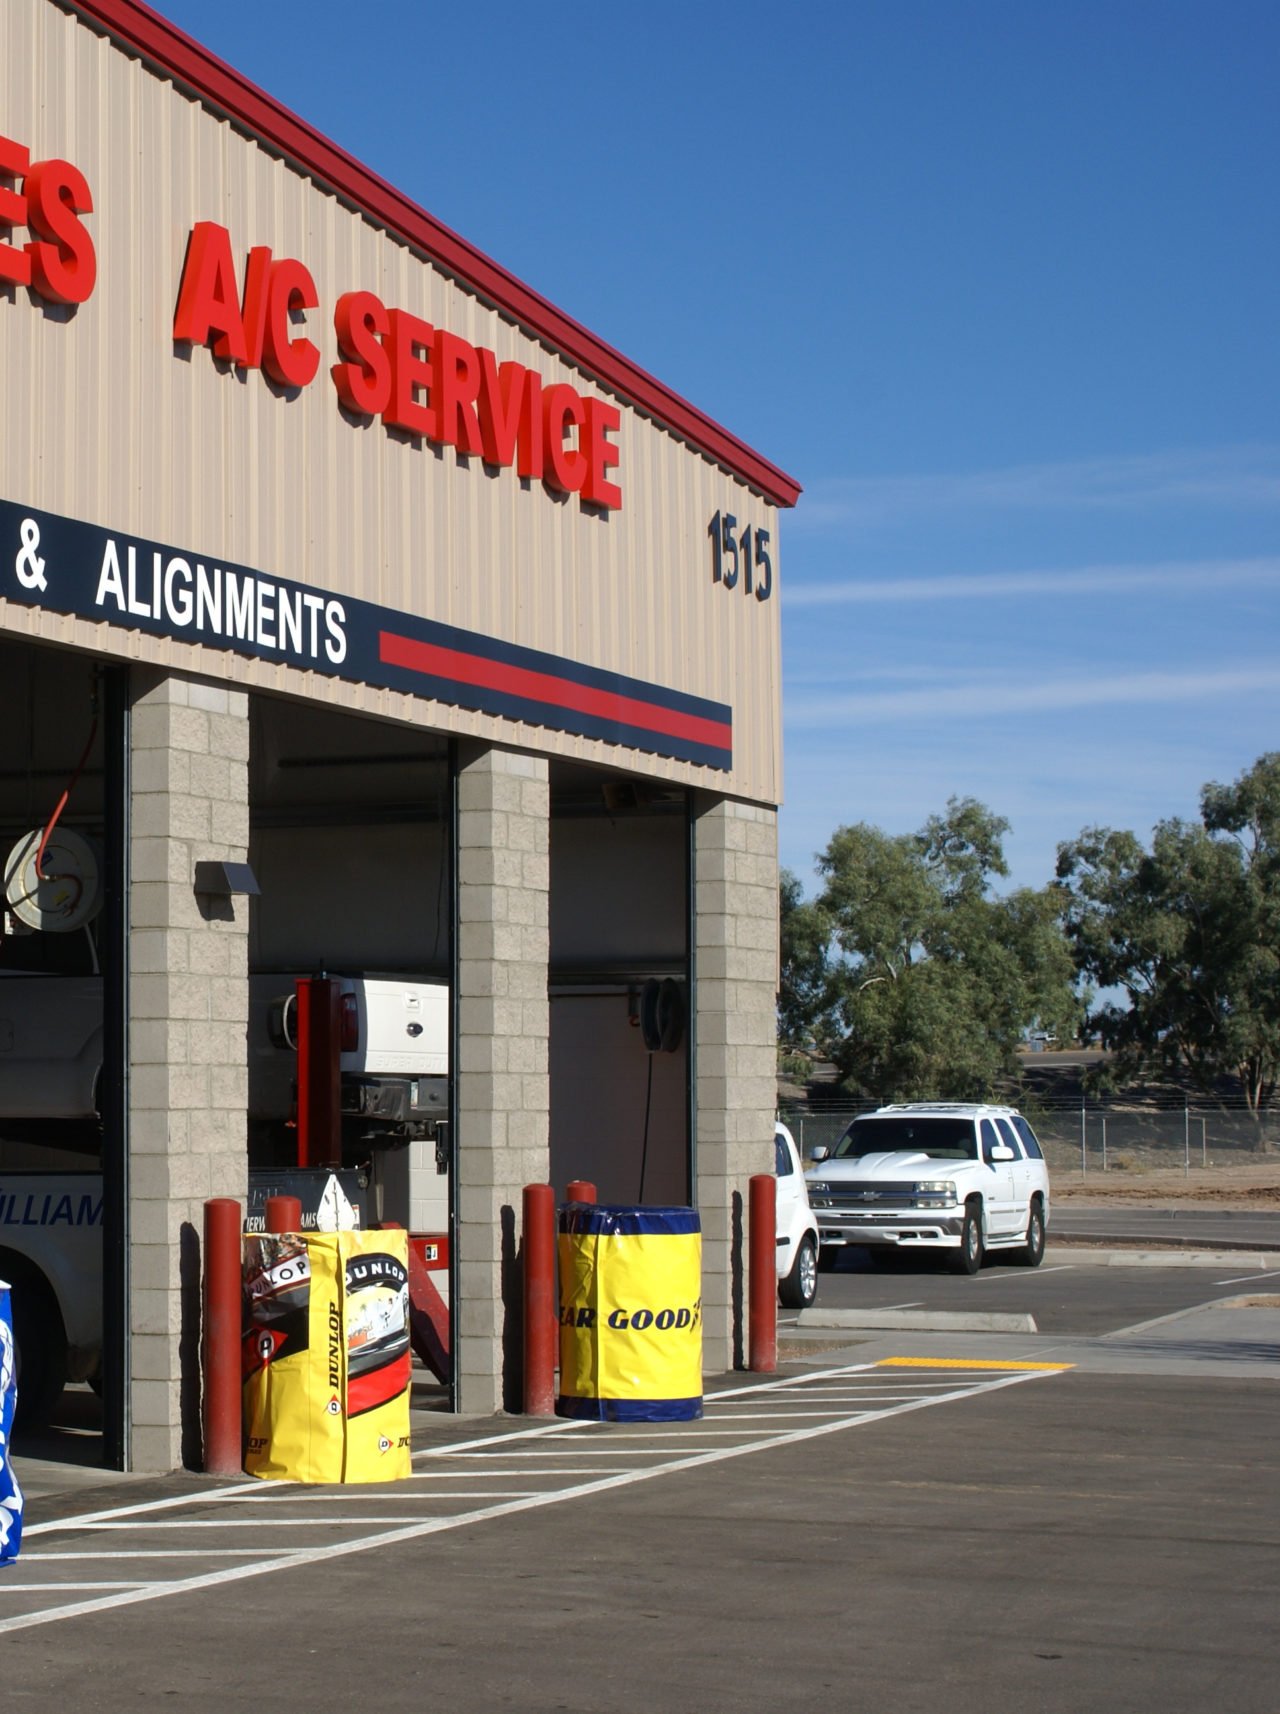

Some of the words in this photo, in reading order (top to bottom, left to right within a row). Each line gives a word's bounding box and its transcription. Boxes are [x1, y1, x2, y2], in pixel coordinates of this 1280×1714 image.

[173, 221, 321, 387] A/C
[331, 290, 622, 511] SERVICE
[16, 518, 47, 592] &
[95, 539, 347, 664] ALIGNMENTS
[708, 509, 772, 602] 1515
[328, 1301, 339, 1390] DUNLOP
